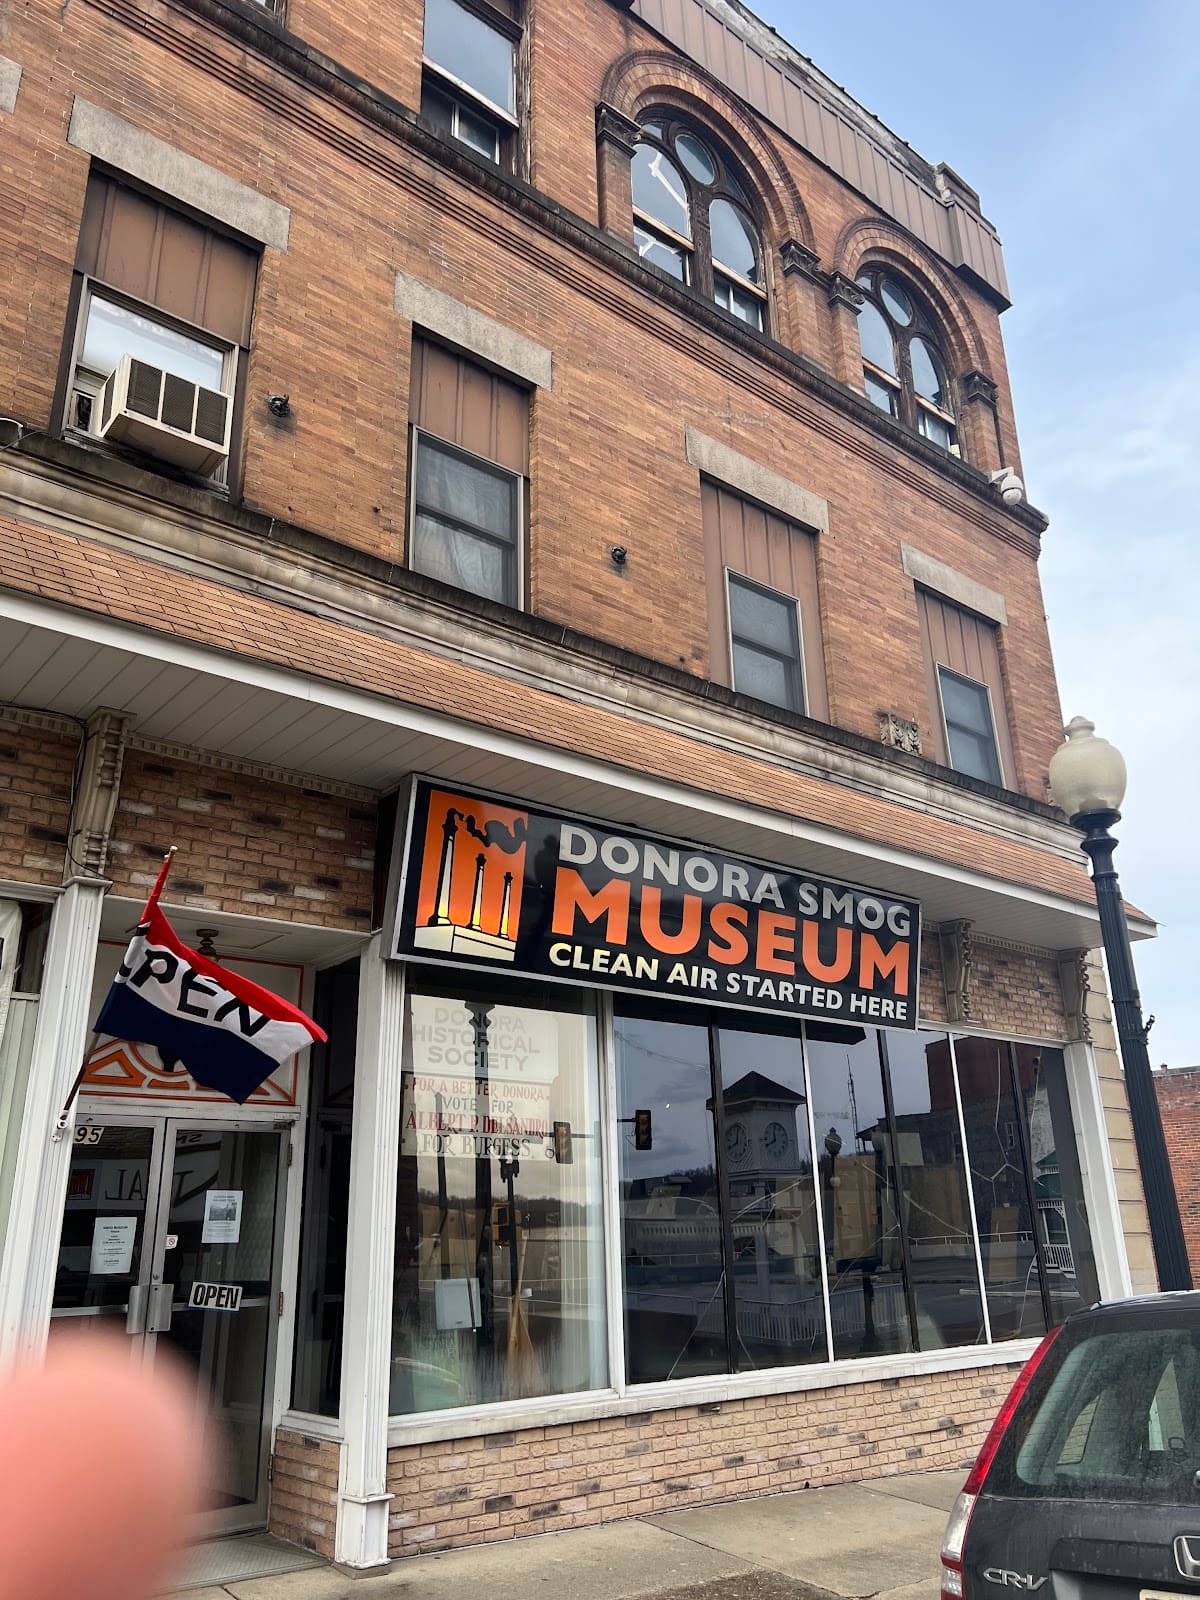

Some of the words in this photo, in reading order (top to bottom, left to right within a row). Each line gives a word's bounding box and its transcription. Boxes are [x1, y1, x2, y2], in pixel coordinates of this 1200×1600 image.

[559, 824, 785, 909] DONORA
[798, 882, 911, 937] SMOG
[552, 866, 910, 996] MUSEUM
[549, 942, 659, 981] CLEAN
[666, 962, 718, 991] AIR
[726, 972, 843, 1010] STARTED
[850, 993, 908, 1020] HERE
[434, 1007, 526, 1034] DONORA
[413, 1023, 541, 1054] HISTORICAL
[428, 1045, 529, 1072] SOCIETY
[412, 1077, 436, 1094] FOR
[440, 1080, 448, 1093] A
[452, 1081, 498, 1100] BETTER
[442, 1096, 477, 1111] VOTE
[491, 1099, 515, 1115] FOR
[405, 1111, 465, 1135] ALBERT
[422, 1134, 457, 1156] FOR
[193, 1283, 240, 1309] OPEN
[983, 1567, 1049, 1591] CR-V
